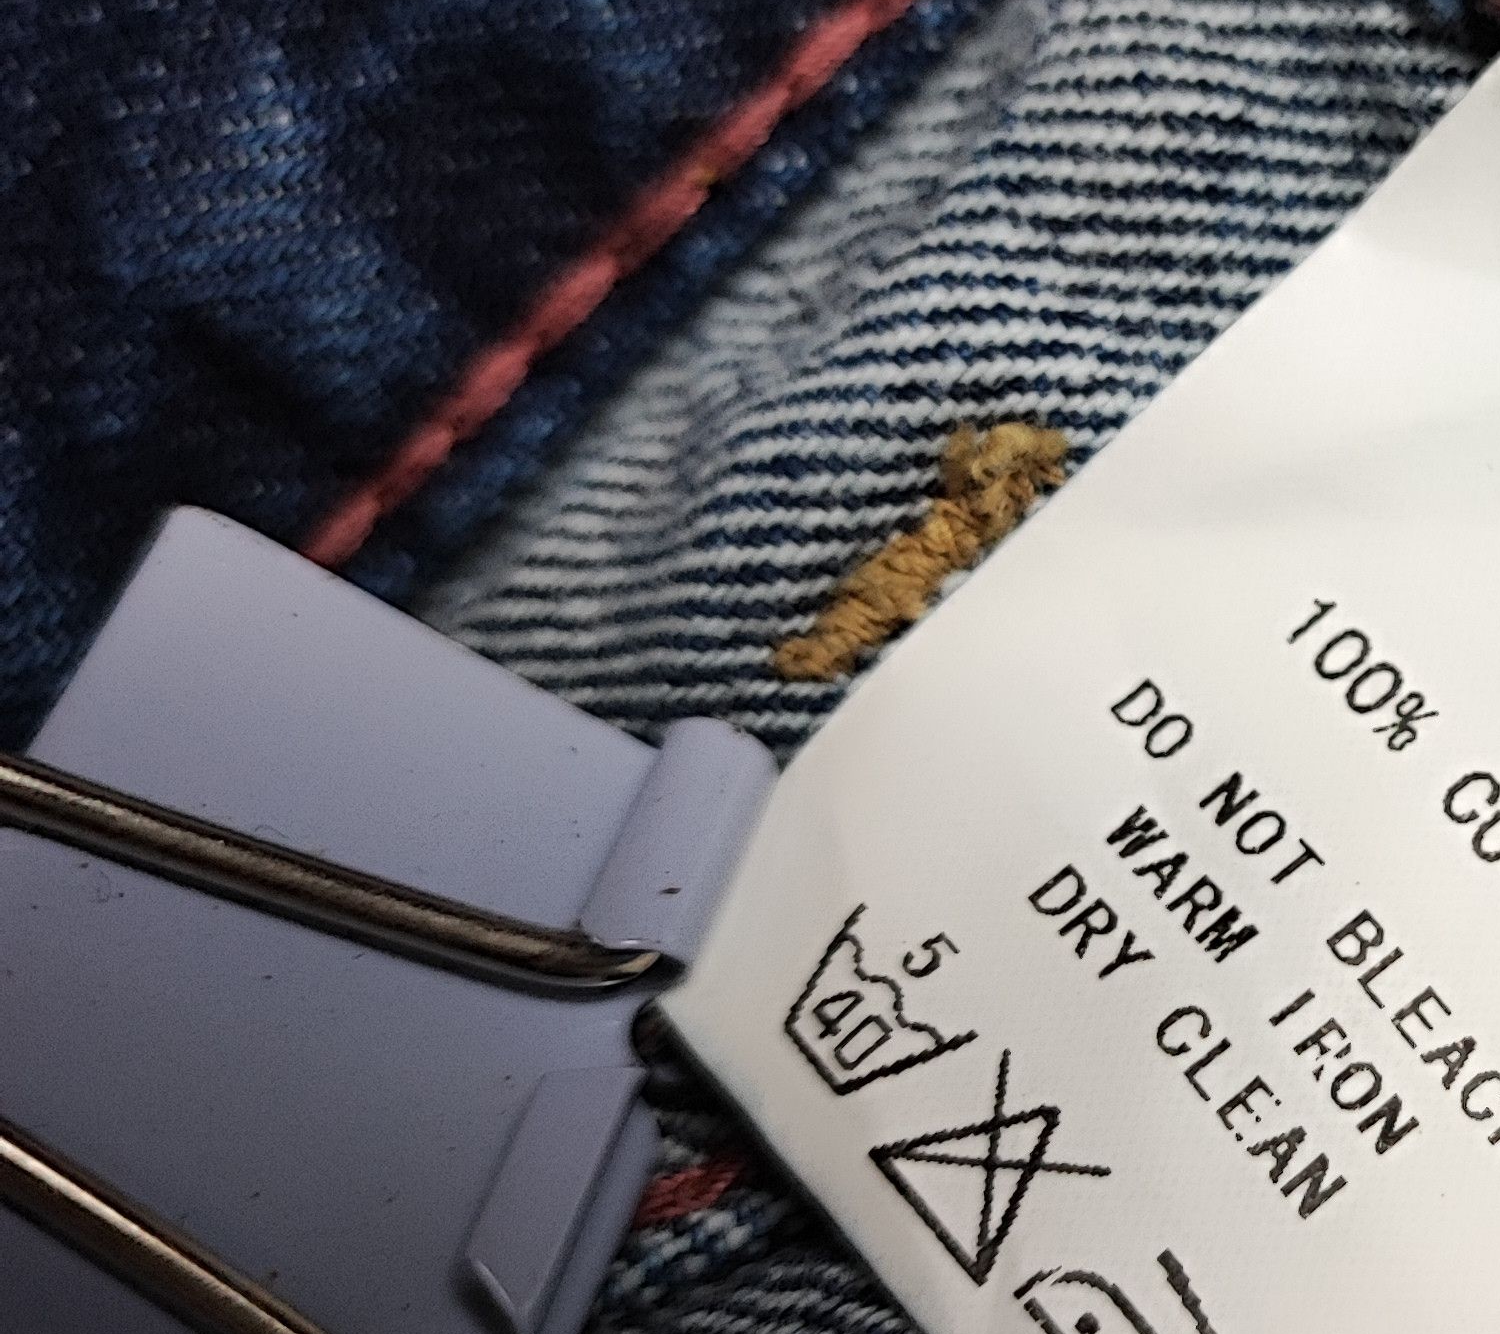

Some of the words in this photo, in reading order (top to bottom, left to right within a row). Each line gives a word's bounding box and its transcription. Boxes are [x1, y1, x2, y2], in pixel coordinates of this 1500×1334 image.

[1287, 599, 1439, 751] 100%
[1111, 678, 1193, 758] DO
[1199, 772, 1325, 882] NOT
[813, 991, 893, 1070] 40
[902, 932, 960, 978] 5
[1028, 864, 1155, 979] DRY
[1156, 1006, 1348, 1220] CLEAN
[1107, 805, 1259, 963] WARM
[1269, 988, 1419, 1155] IRON
